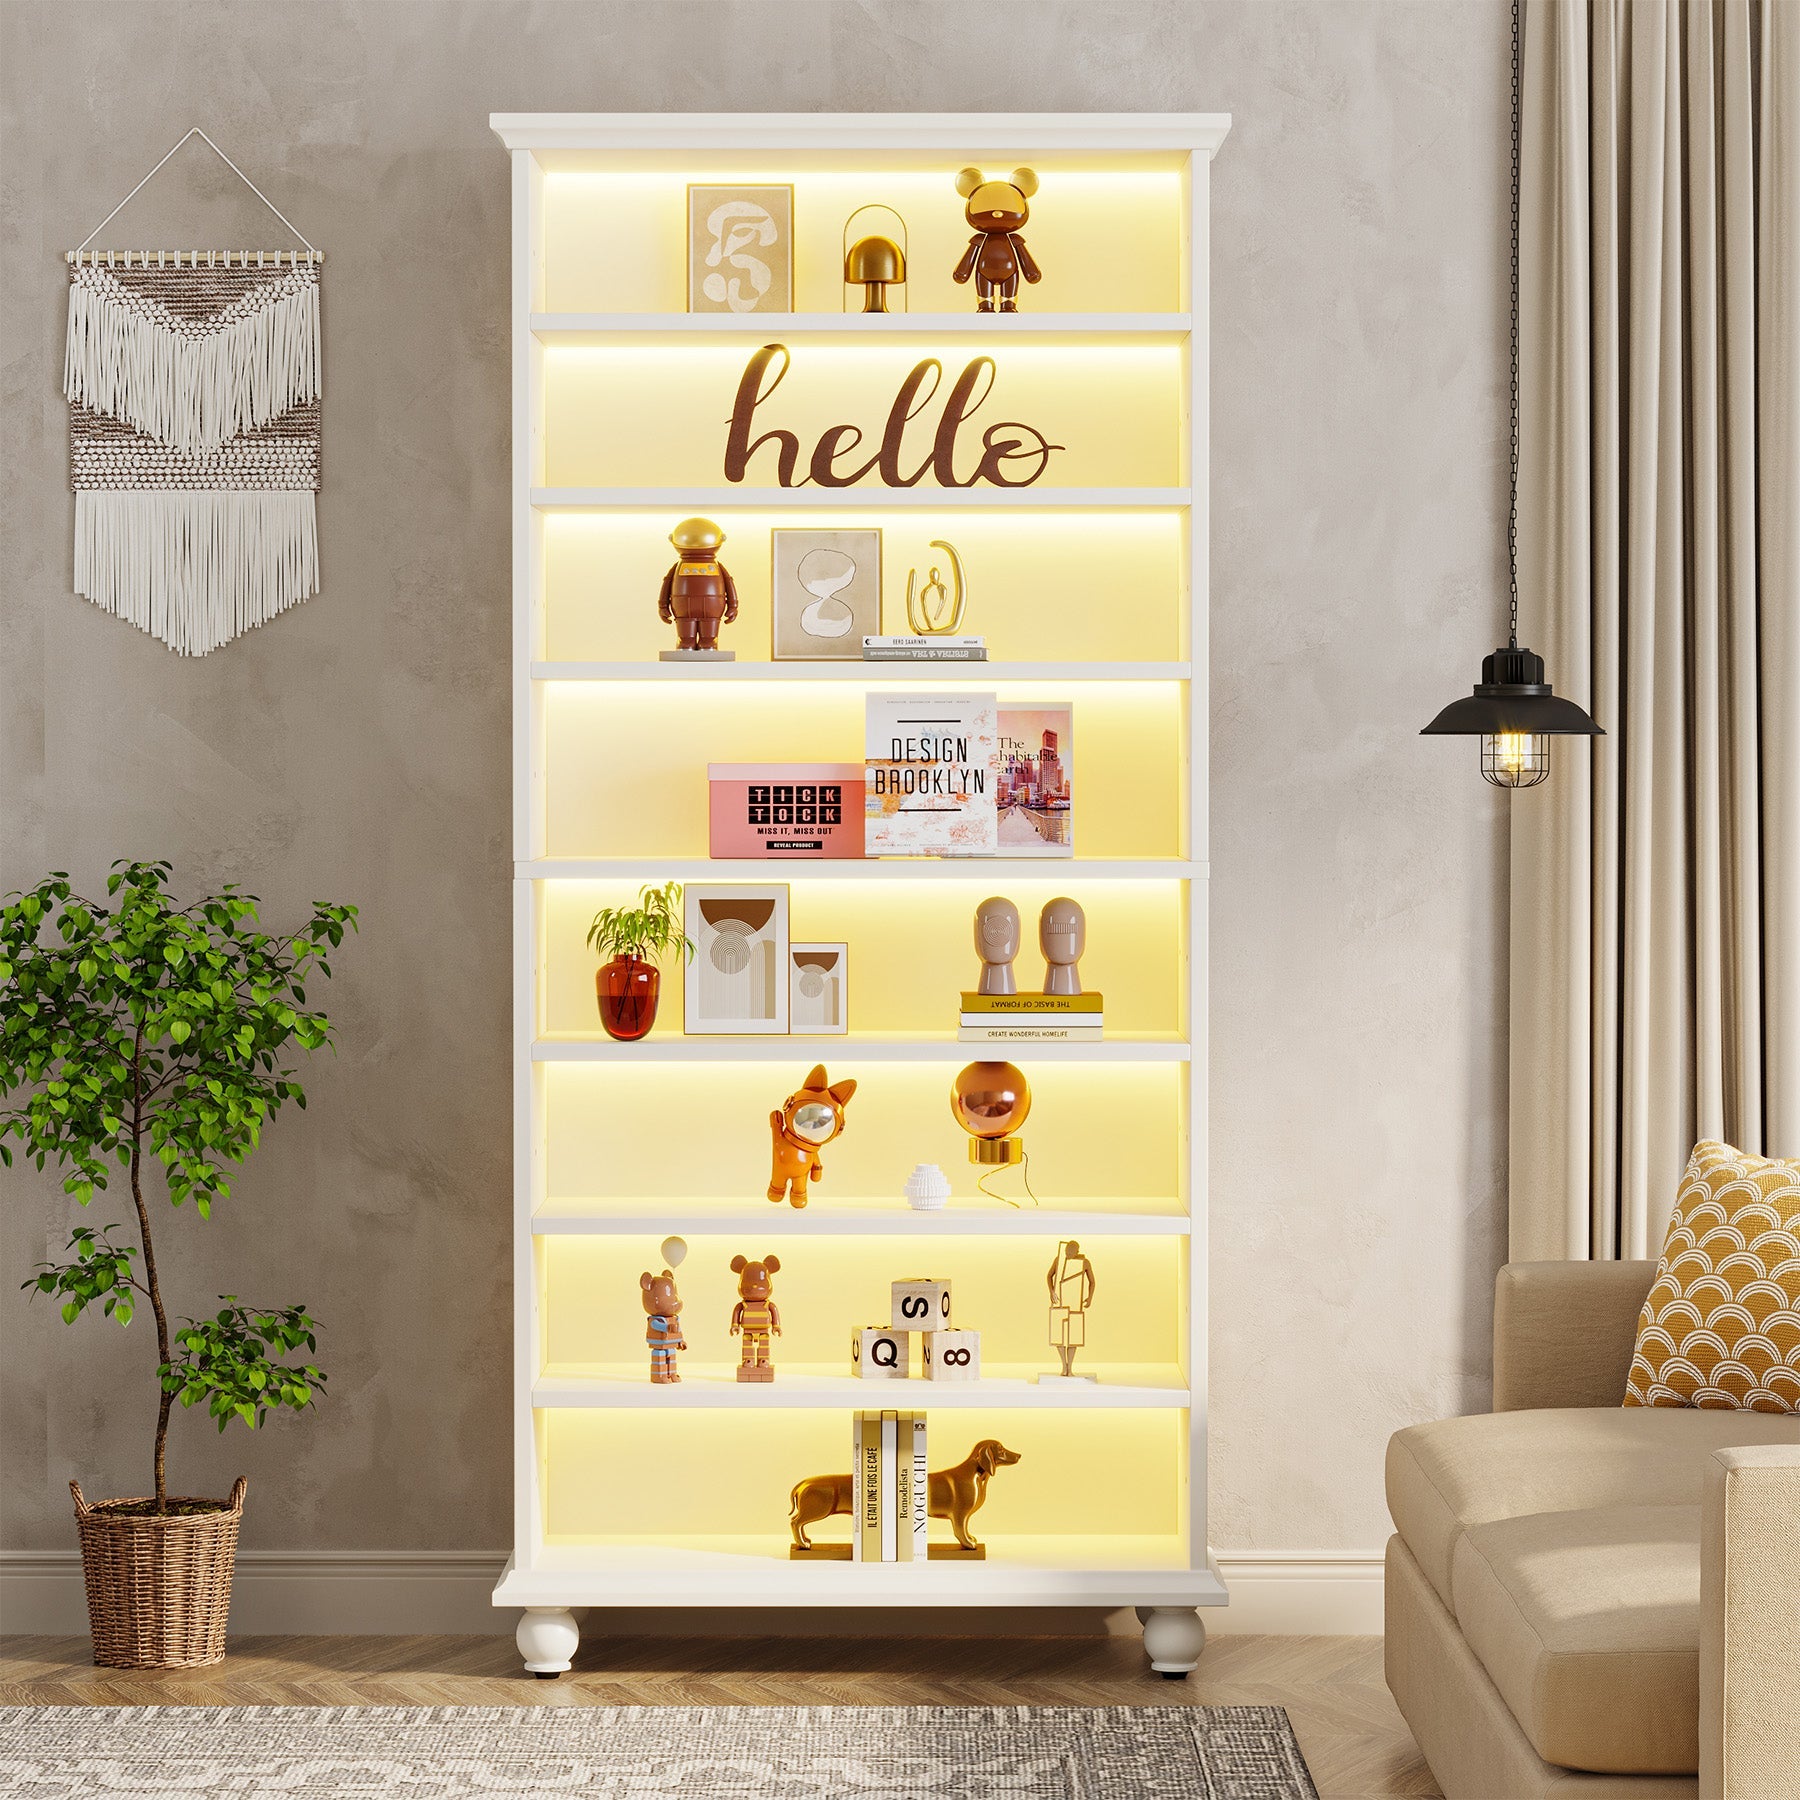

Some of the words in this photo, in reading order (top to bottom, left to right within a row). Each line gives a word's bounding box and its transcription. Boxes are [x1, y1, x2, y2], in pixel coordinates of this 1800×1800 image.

[724, 343, 1066, 488] hello
[891, 737, 967, 763] DESIGN
[997, 737, 1025, 749] The
[875, 769, 984, 794] BROOKLYN
[754, 788, 835, 802] TICK
[754, 808, 835, 822] TOCK
[757, 827, 778, 835] MISS
[780, 827, 790, 836] IT,
[793, 827, 814, 835] MISS
[817, 827, 833, 835] OUT
[987, 1030, 1008, 1038] CREATE
[1009, 1030, 1041, 1038] WONDERFUL
[1042, 1030, 1068, 1038] HOMELIFE
[901, 1295, 929, 1319] S
[871, 1338, 898, 1369] Q
[943, 1348, 971, 1367] 8
[866, 1447, 877, 1464] CAFÉ
[867, 1465, 877, 1473] LE
[867, 1473, 877, 1488] FOIS
[867, 1489, 877, 1502] UNE
[899, 1468, 908, 1519] Remodelista
[914, 1455, 926, 1533] NOGUCHI
[866, 1503, 877, 1521] ÉTAIT
